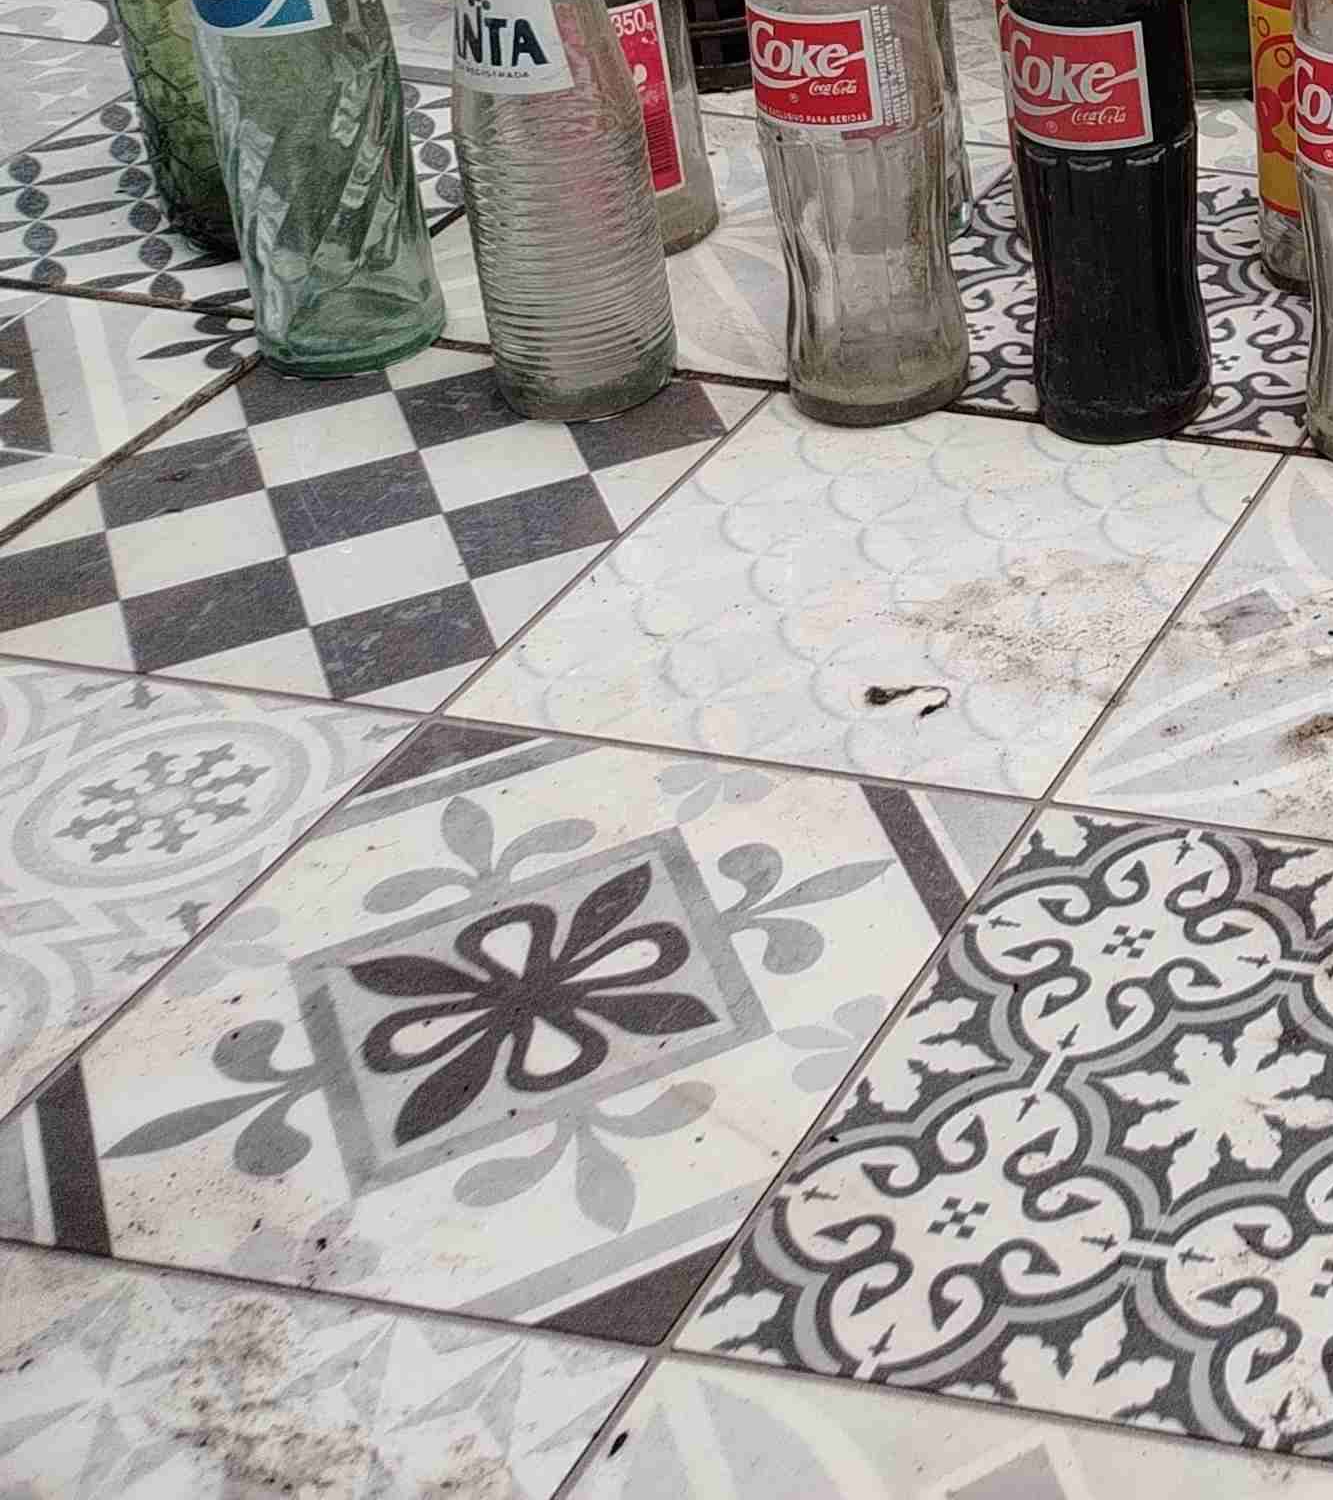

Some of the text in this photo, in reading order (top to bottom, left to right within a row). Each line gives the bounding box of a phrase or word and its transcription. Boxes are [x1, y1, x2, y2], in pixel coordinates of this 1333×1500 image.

[611, 8, 647, 38] 350
[752, 19, 850, 79] Coke
[1010, 30, 1117, 104] Coke
